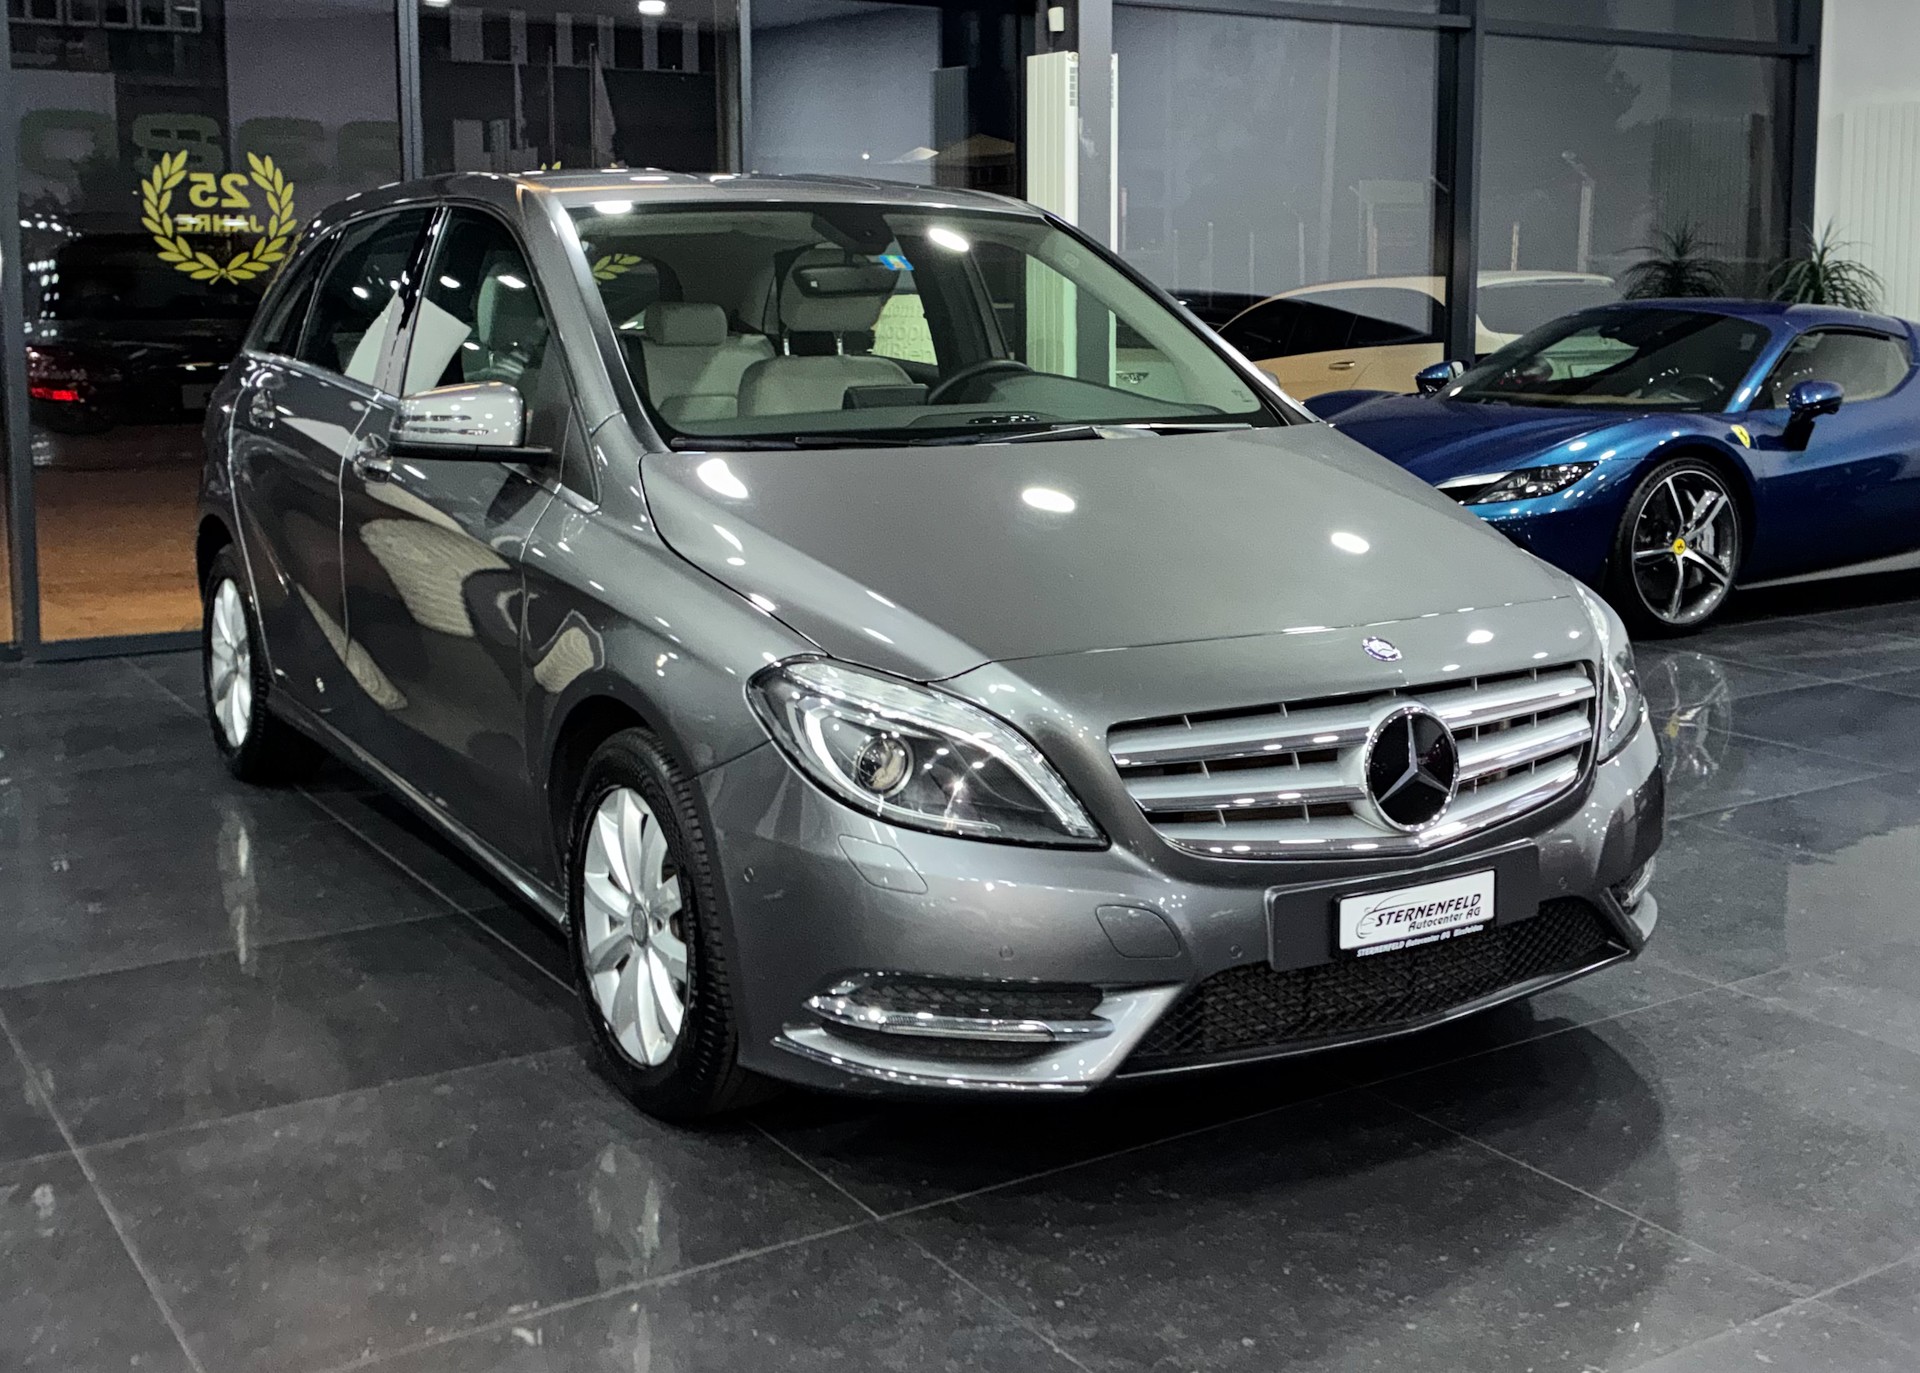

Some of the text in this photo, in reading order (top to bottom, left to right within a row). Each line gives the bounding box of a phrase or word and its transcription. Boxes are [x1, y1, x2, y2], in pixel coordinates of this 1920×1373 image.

[1375, 893, 1481, 927] STERNENFELD
[1408, 907, 1481, 932] Autocenter AG
